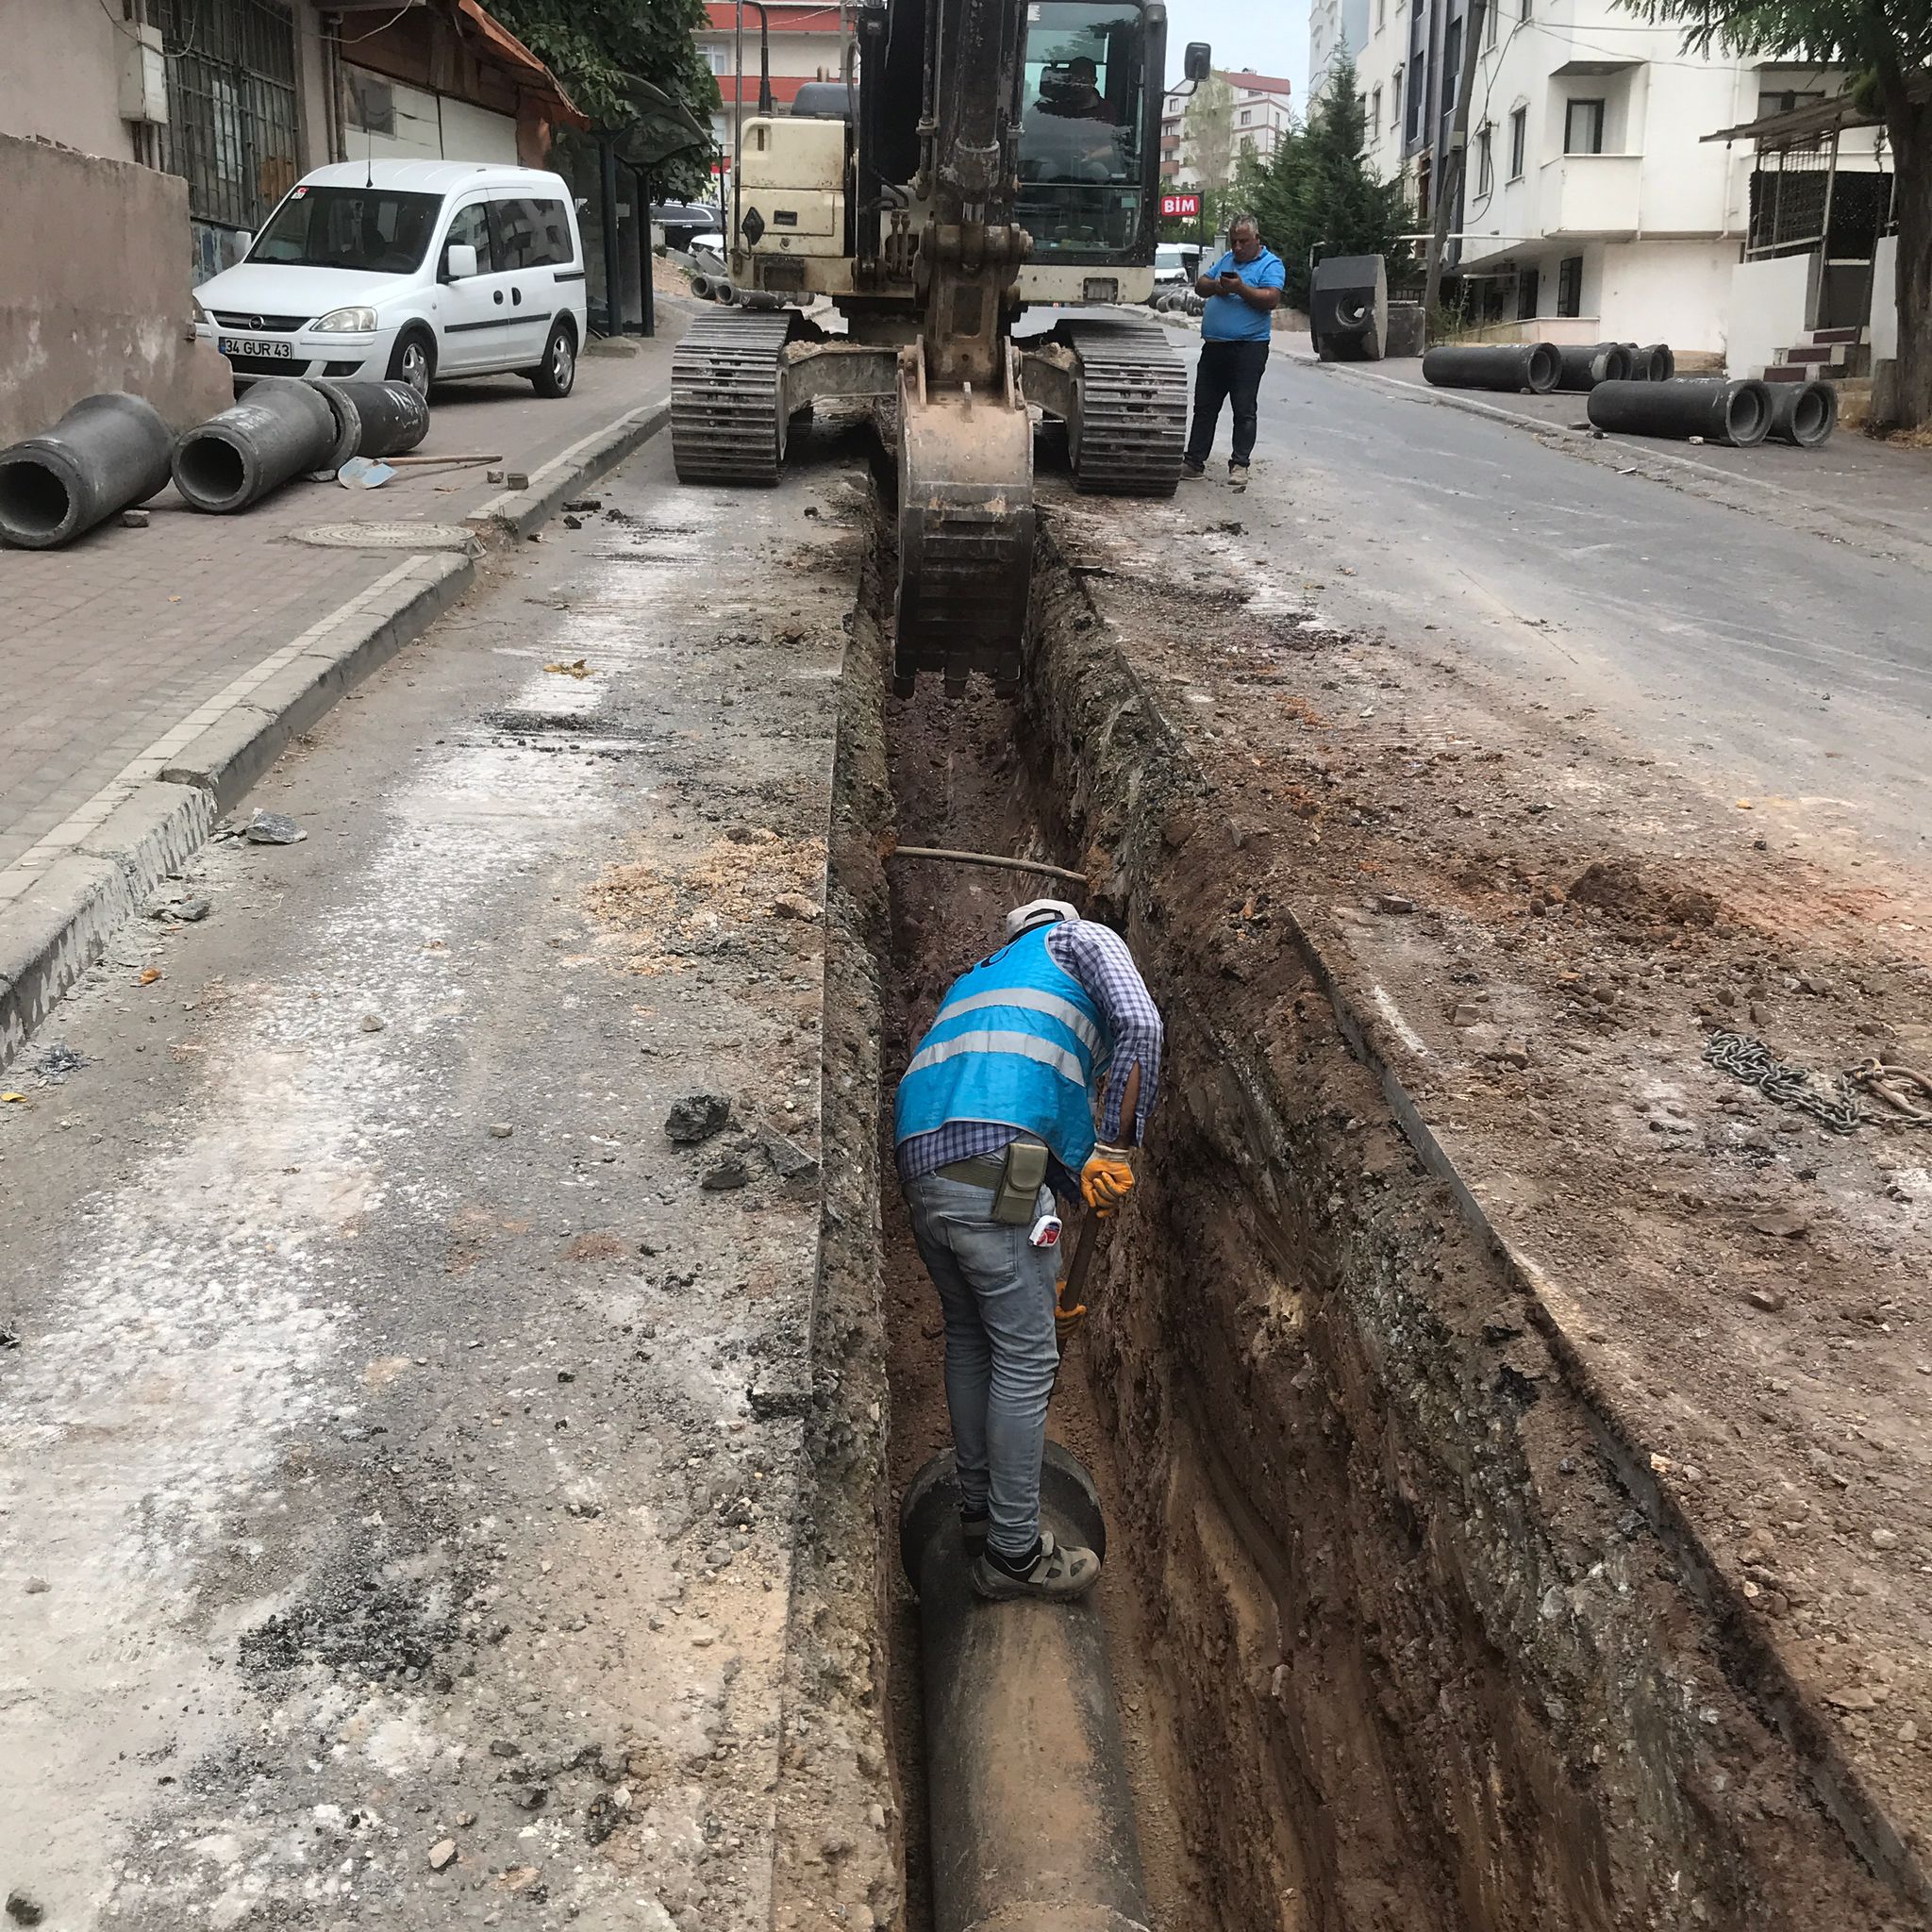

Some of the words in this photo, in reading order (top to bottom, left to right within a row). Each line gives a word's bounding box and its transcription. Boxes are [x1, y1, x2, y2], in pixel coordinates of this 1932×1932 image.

[1164, 196, 1195, 213] BİM
[225, 340, 240, 354] 34
[243, 341, 271, 357] GUR
[274, 343, 290, 358] 43
